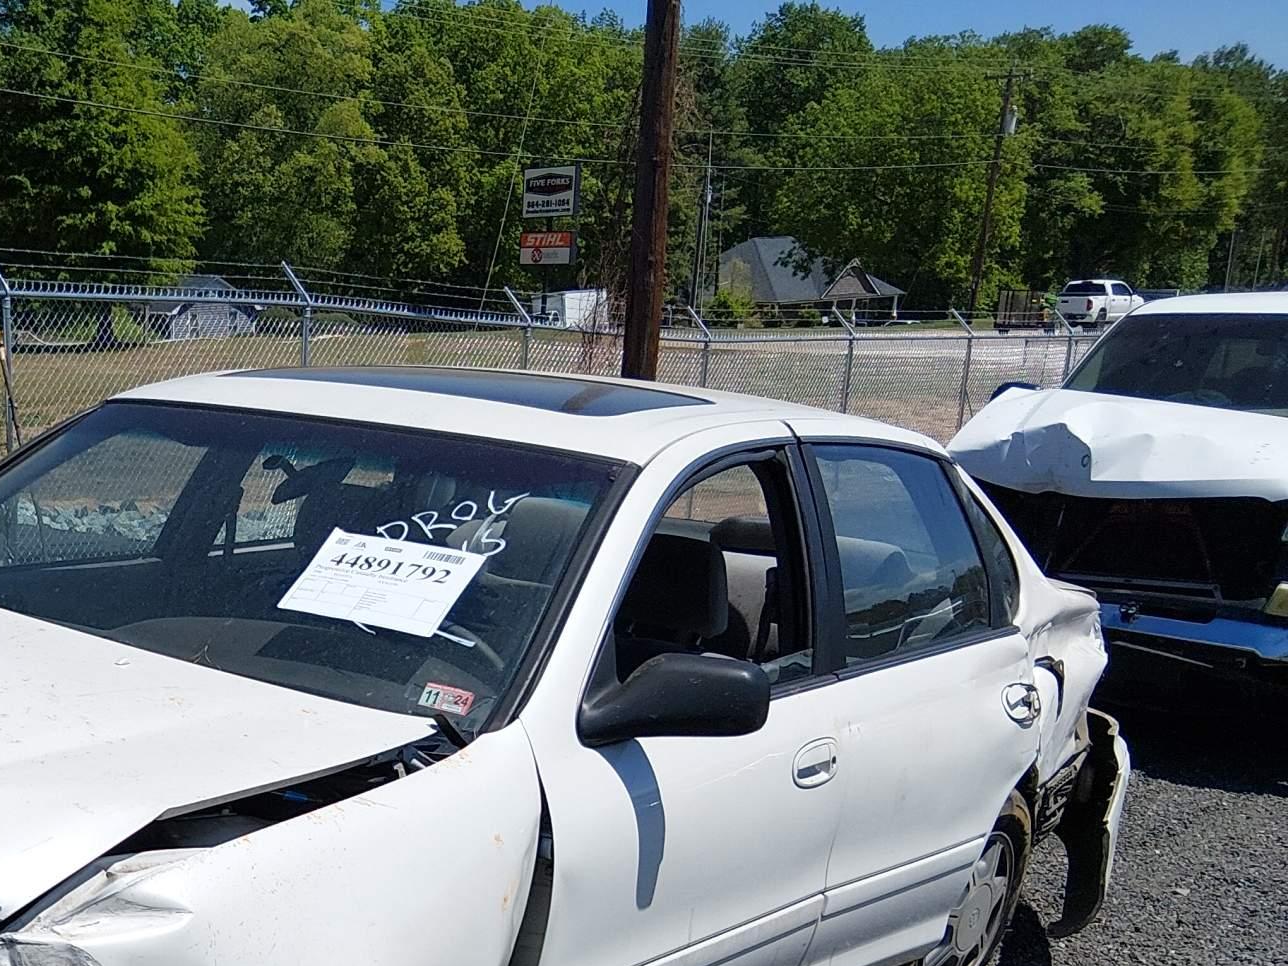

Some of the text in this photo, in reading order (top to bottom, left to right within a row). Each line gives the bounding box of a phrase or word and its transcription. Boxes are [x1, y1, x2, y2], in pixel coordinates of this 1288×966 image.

[527, 233, 565, 246] STIHL
[330, 552, 453, 584] 44891792
[425, 689, 470, 707] 11 24
